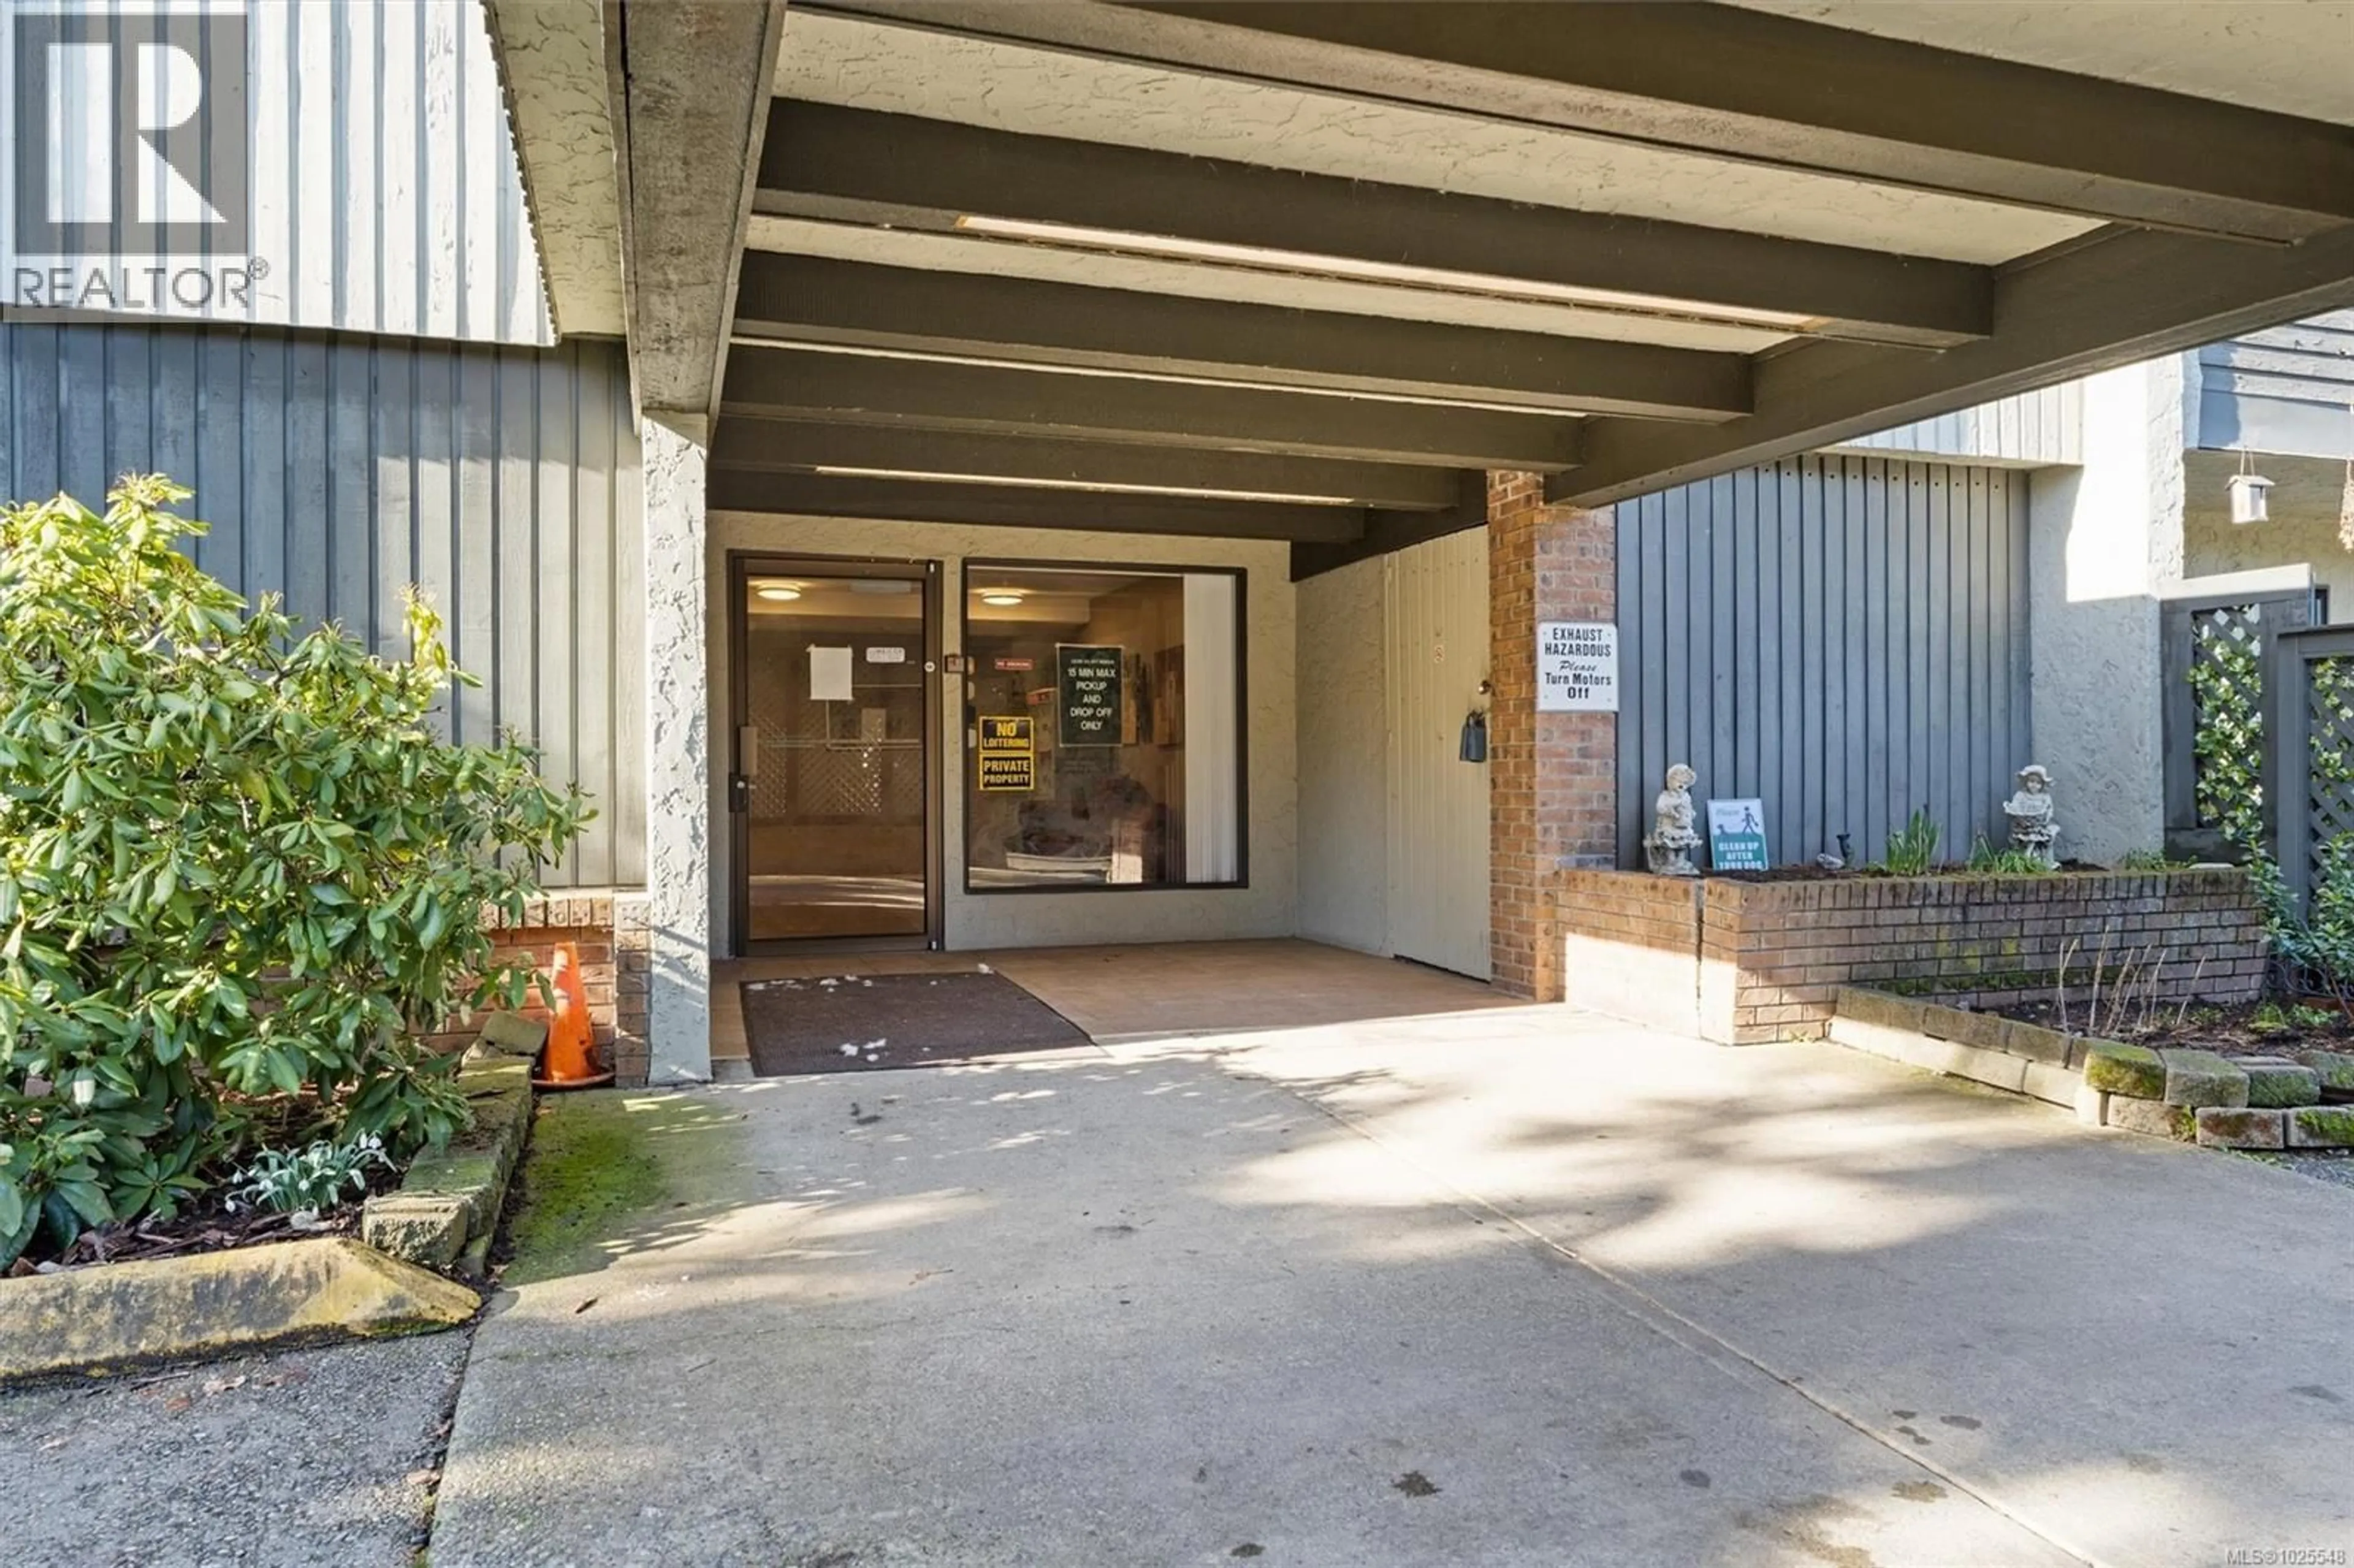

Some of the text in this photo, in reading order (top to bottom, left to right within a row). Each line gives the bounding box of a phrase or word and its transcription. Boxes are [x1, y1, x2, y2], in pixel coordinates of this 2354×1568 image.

[1553, 628, 1603, 642] EXHAUST
[1544, 642, 1612, 657] HAZARDOUS
[1560, 660, 1597, 671] Please
[1067, 668, 1116, 678] 15 MIN MAX
[1545, 672, 1612, 686] Turn Motors
[1076, 681, 1107, 691] PICKUP
[1567, 687, 1590, 699] Off
[1083, 694, 1102, 704] AND
[1070, 707, 1113, 717] DROP OFF
[997, 722, 1017, 737] NO
[1081, 720, 1103, 730] ONLY
[984, 738, 1029, 748] LOITERING
[984, 760, 1030, 772] PRIVATE
[984, 774, 1029, 784] PROPERTY
